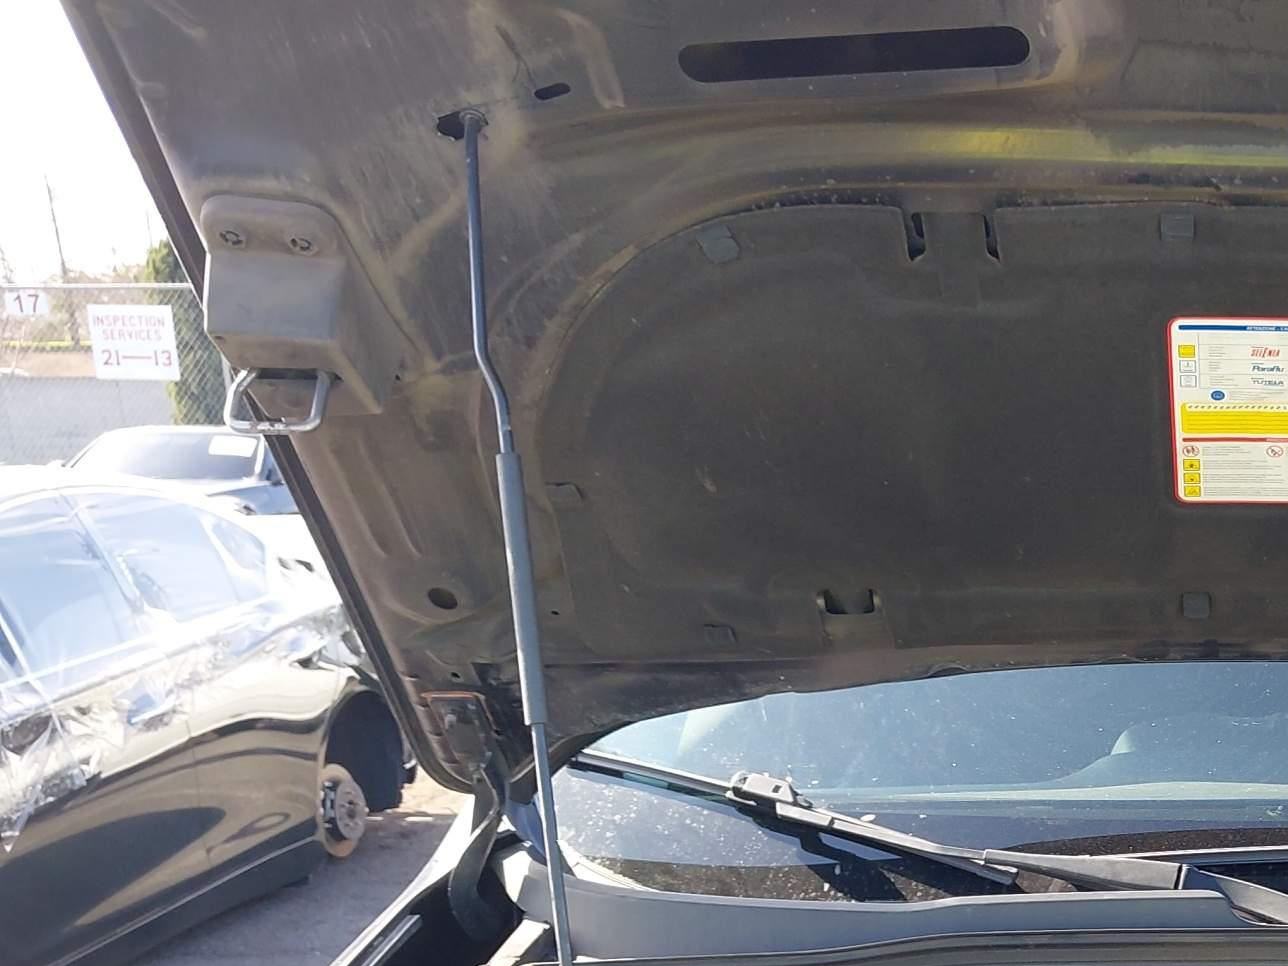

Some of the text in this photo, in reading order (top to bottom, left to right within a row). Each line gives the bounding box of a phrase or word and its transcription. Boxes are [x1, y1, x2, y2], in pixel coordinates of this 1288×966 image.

[14, 293, 40, 313] 17
[93, 315, 165, 327] INSPECTION
[102, 329, 162, 341] SERVICES
